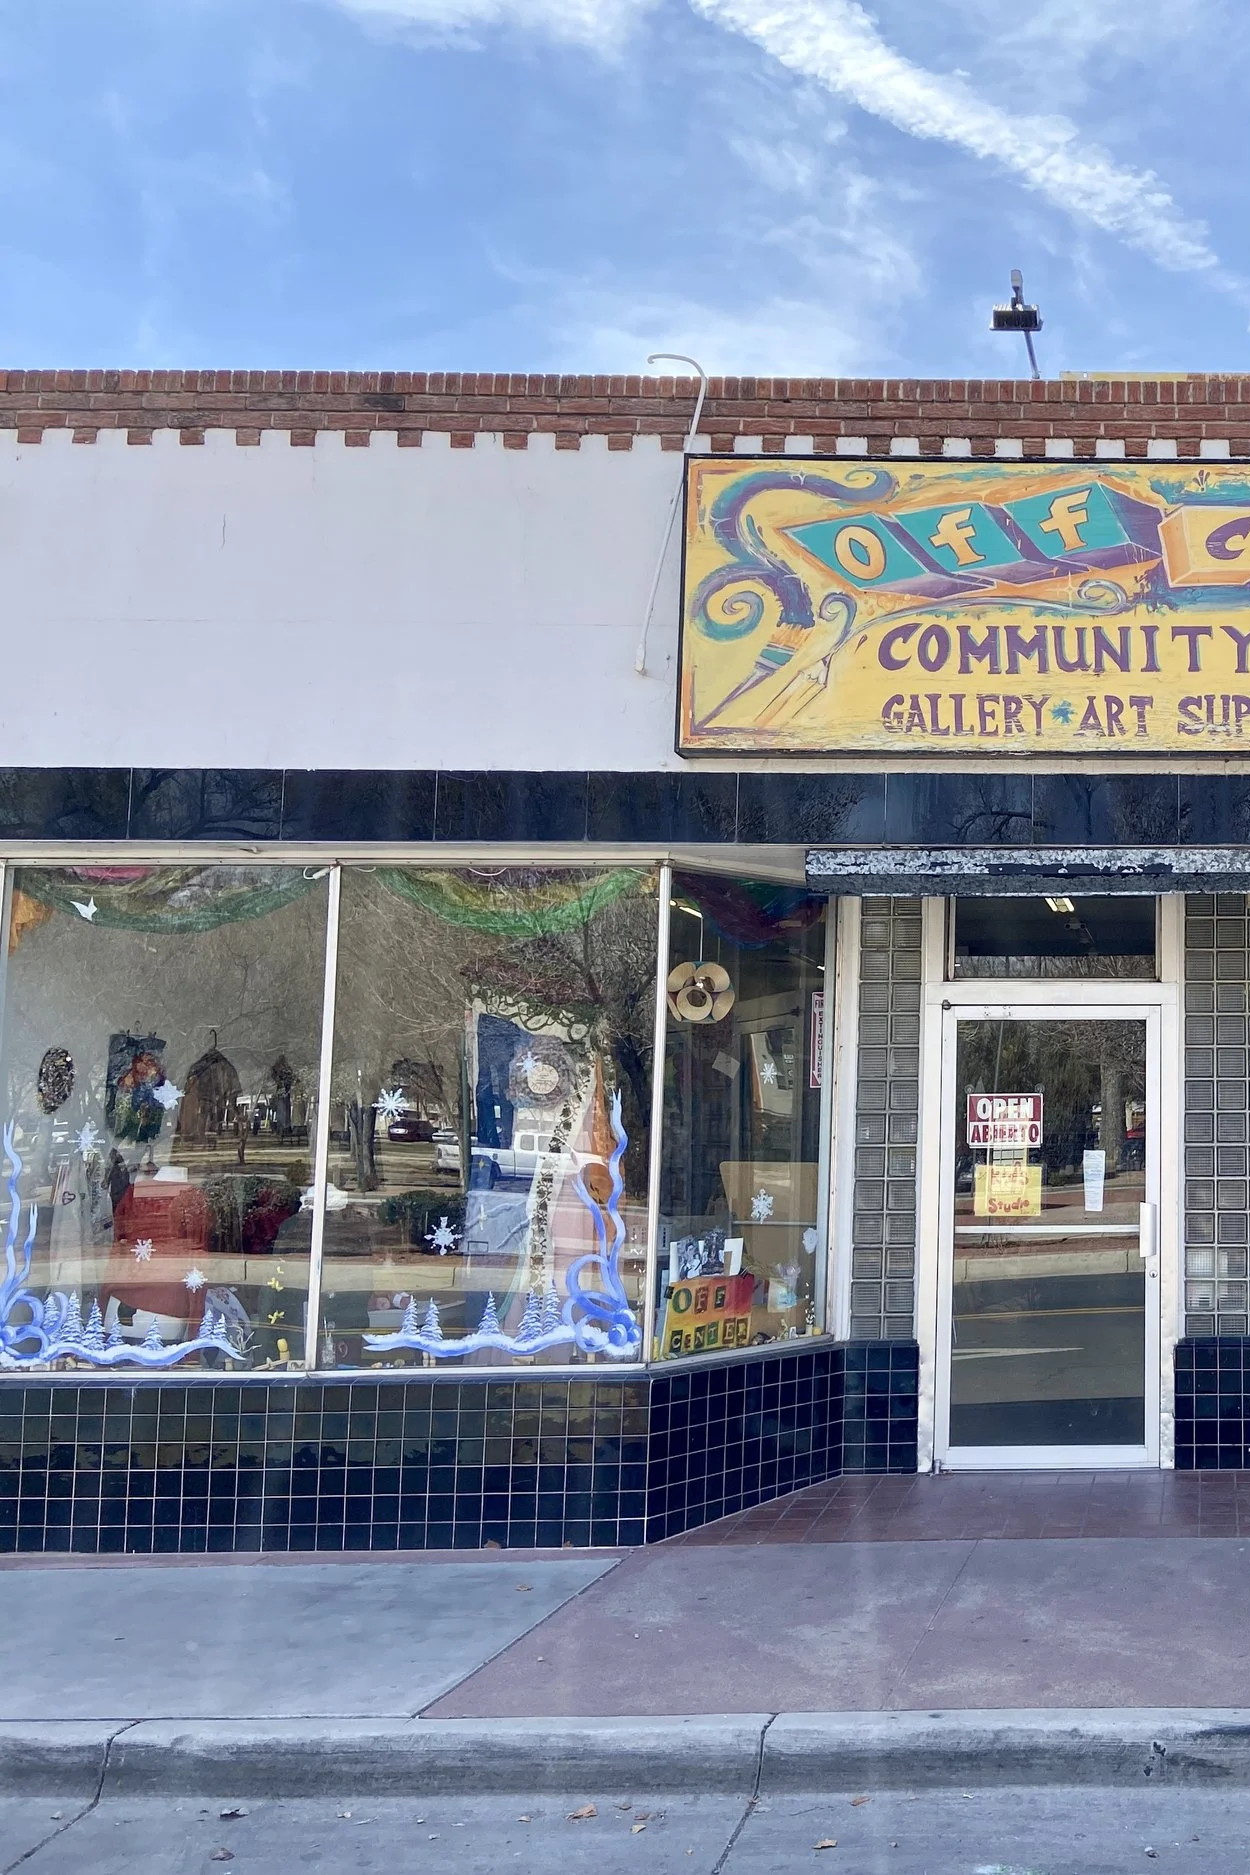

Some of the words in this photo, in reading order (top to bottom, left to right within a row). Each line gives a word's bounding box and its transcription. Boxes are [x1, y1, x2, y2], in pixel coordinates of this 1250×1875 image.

[881, 693, 1051, 737] GALLERY
[1080, 694, 1155, 738] ART
[976, 1097, 1034, 1120] OPEN
[672, 1285, 727, 1314] OFF
